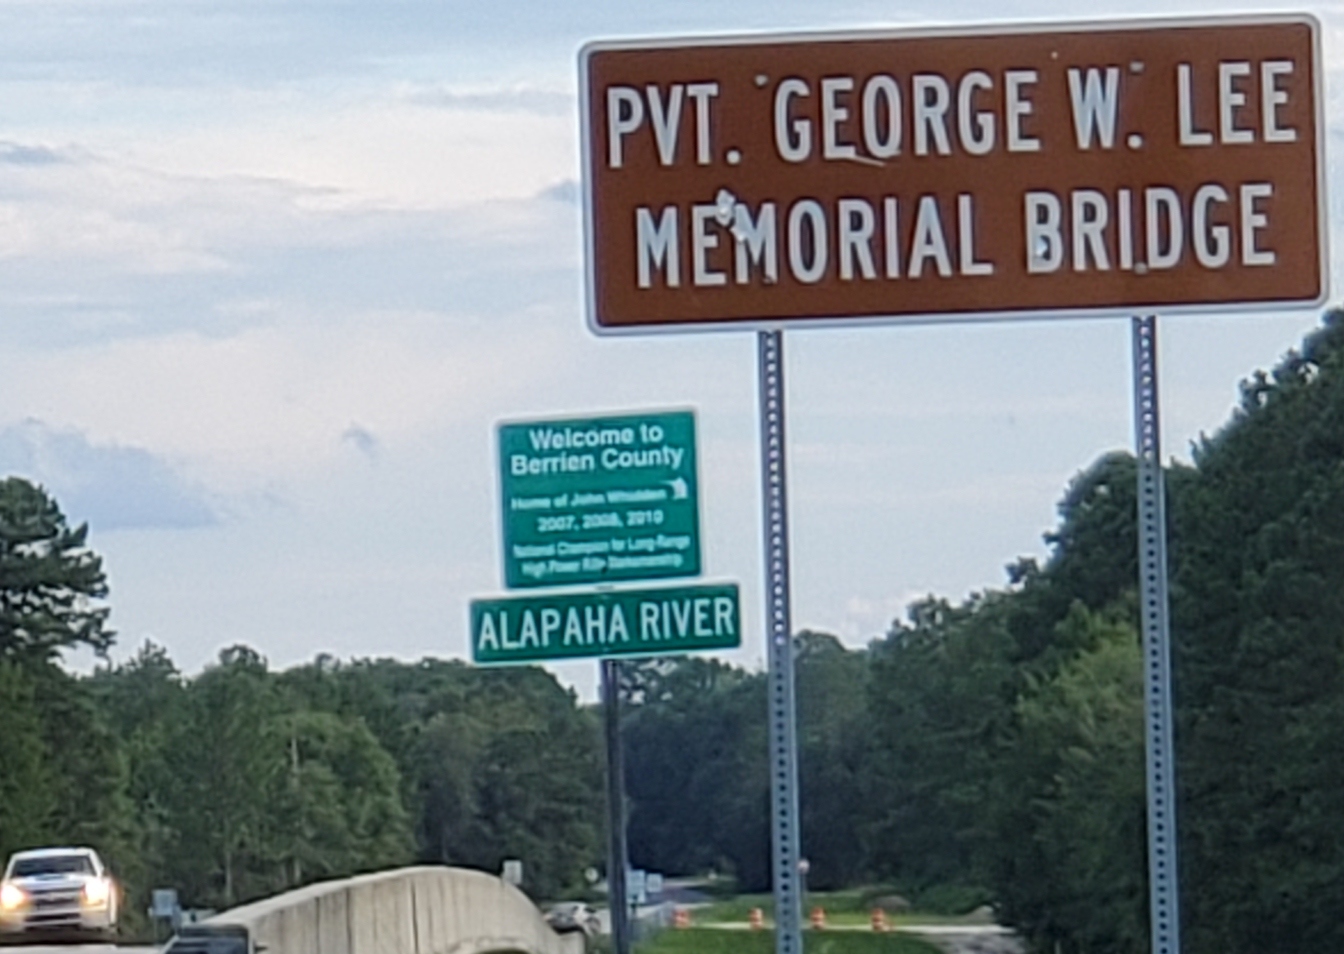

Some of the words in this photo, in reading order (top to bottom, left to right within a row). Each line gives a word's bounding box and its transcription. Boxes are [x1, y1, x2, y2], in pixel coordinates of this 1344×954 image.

[607, 82, 742, 168] PVT.
[775, 70, 1040, 161] GEORGE
[1068, 66, 1143, 149] W.
[1176, 60, 1297, 147] LEE
[635, 193, 993, 288] MEMORIAL
[1026, 183, 1276, 274] BRIDGE
[529, 427, 634, 451] Welcome
[640, 423, 664, 443] to
[511, 452, 595, 475] Berrien
[601, 445, 684, 470] County
[553, 493, 568, 507] of
[478, 604, 629, 651] ALAPAHA
[641, 597, 734, 640] RIVER
